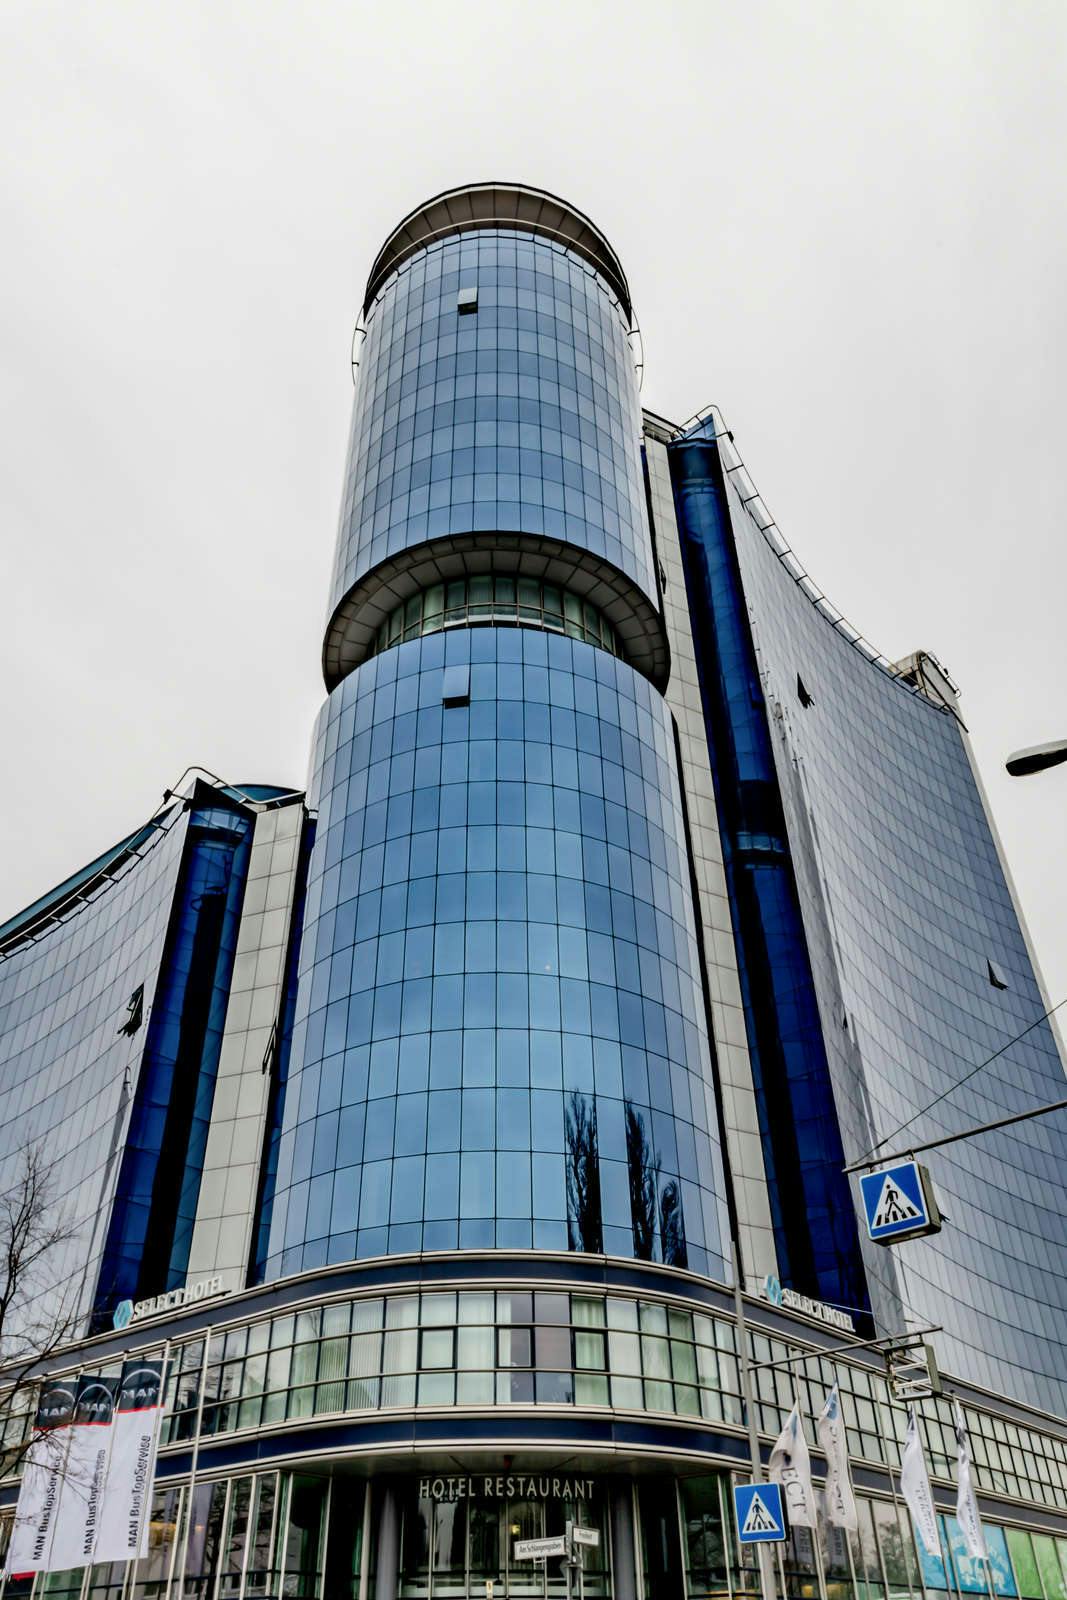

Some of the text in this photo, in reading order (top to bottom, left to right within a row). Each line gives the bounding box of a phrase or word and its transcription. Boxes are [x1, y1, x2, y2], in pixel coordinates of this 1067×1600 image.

[134, 1275, 224, 1320] SELECT HOTEL
[781, 1288, 856, 1333] SELECT HOTEL
[121, 1387, 160, 1400] MAN
[38, 1407, 72, 1417] MAN
[128, 1435, 151, 1547] MAN BusTopService
[419, 1477, 595, 1499] HOTEL RESTAURANT
[32, 1535, 46, 1560] MAN
[83, 1528, 95, 1554] MAN
